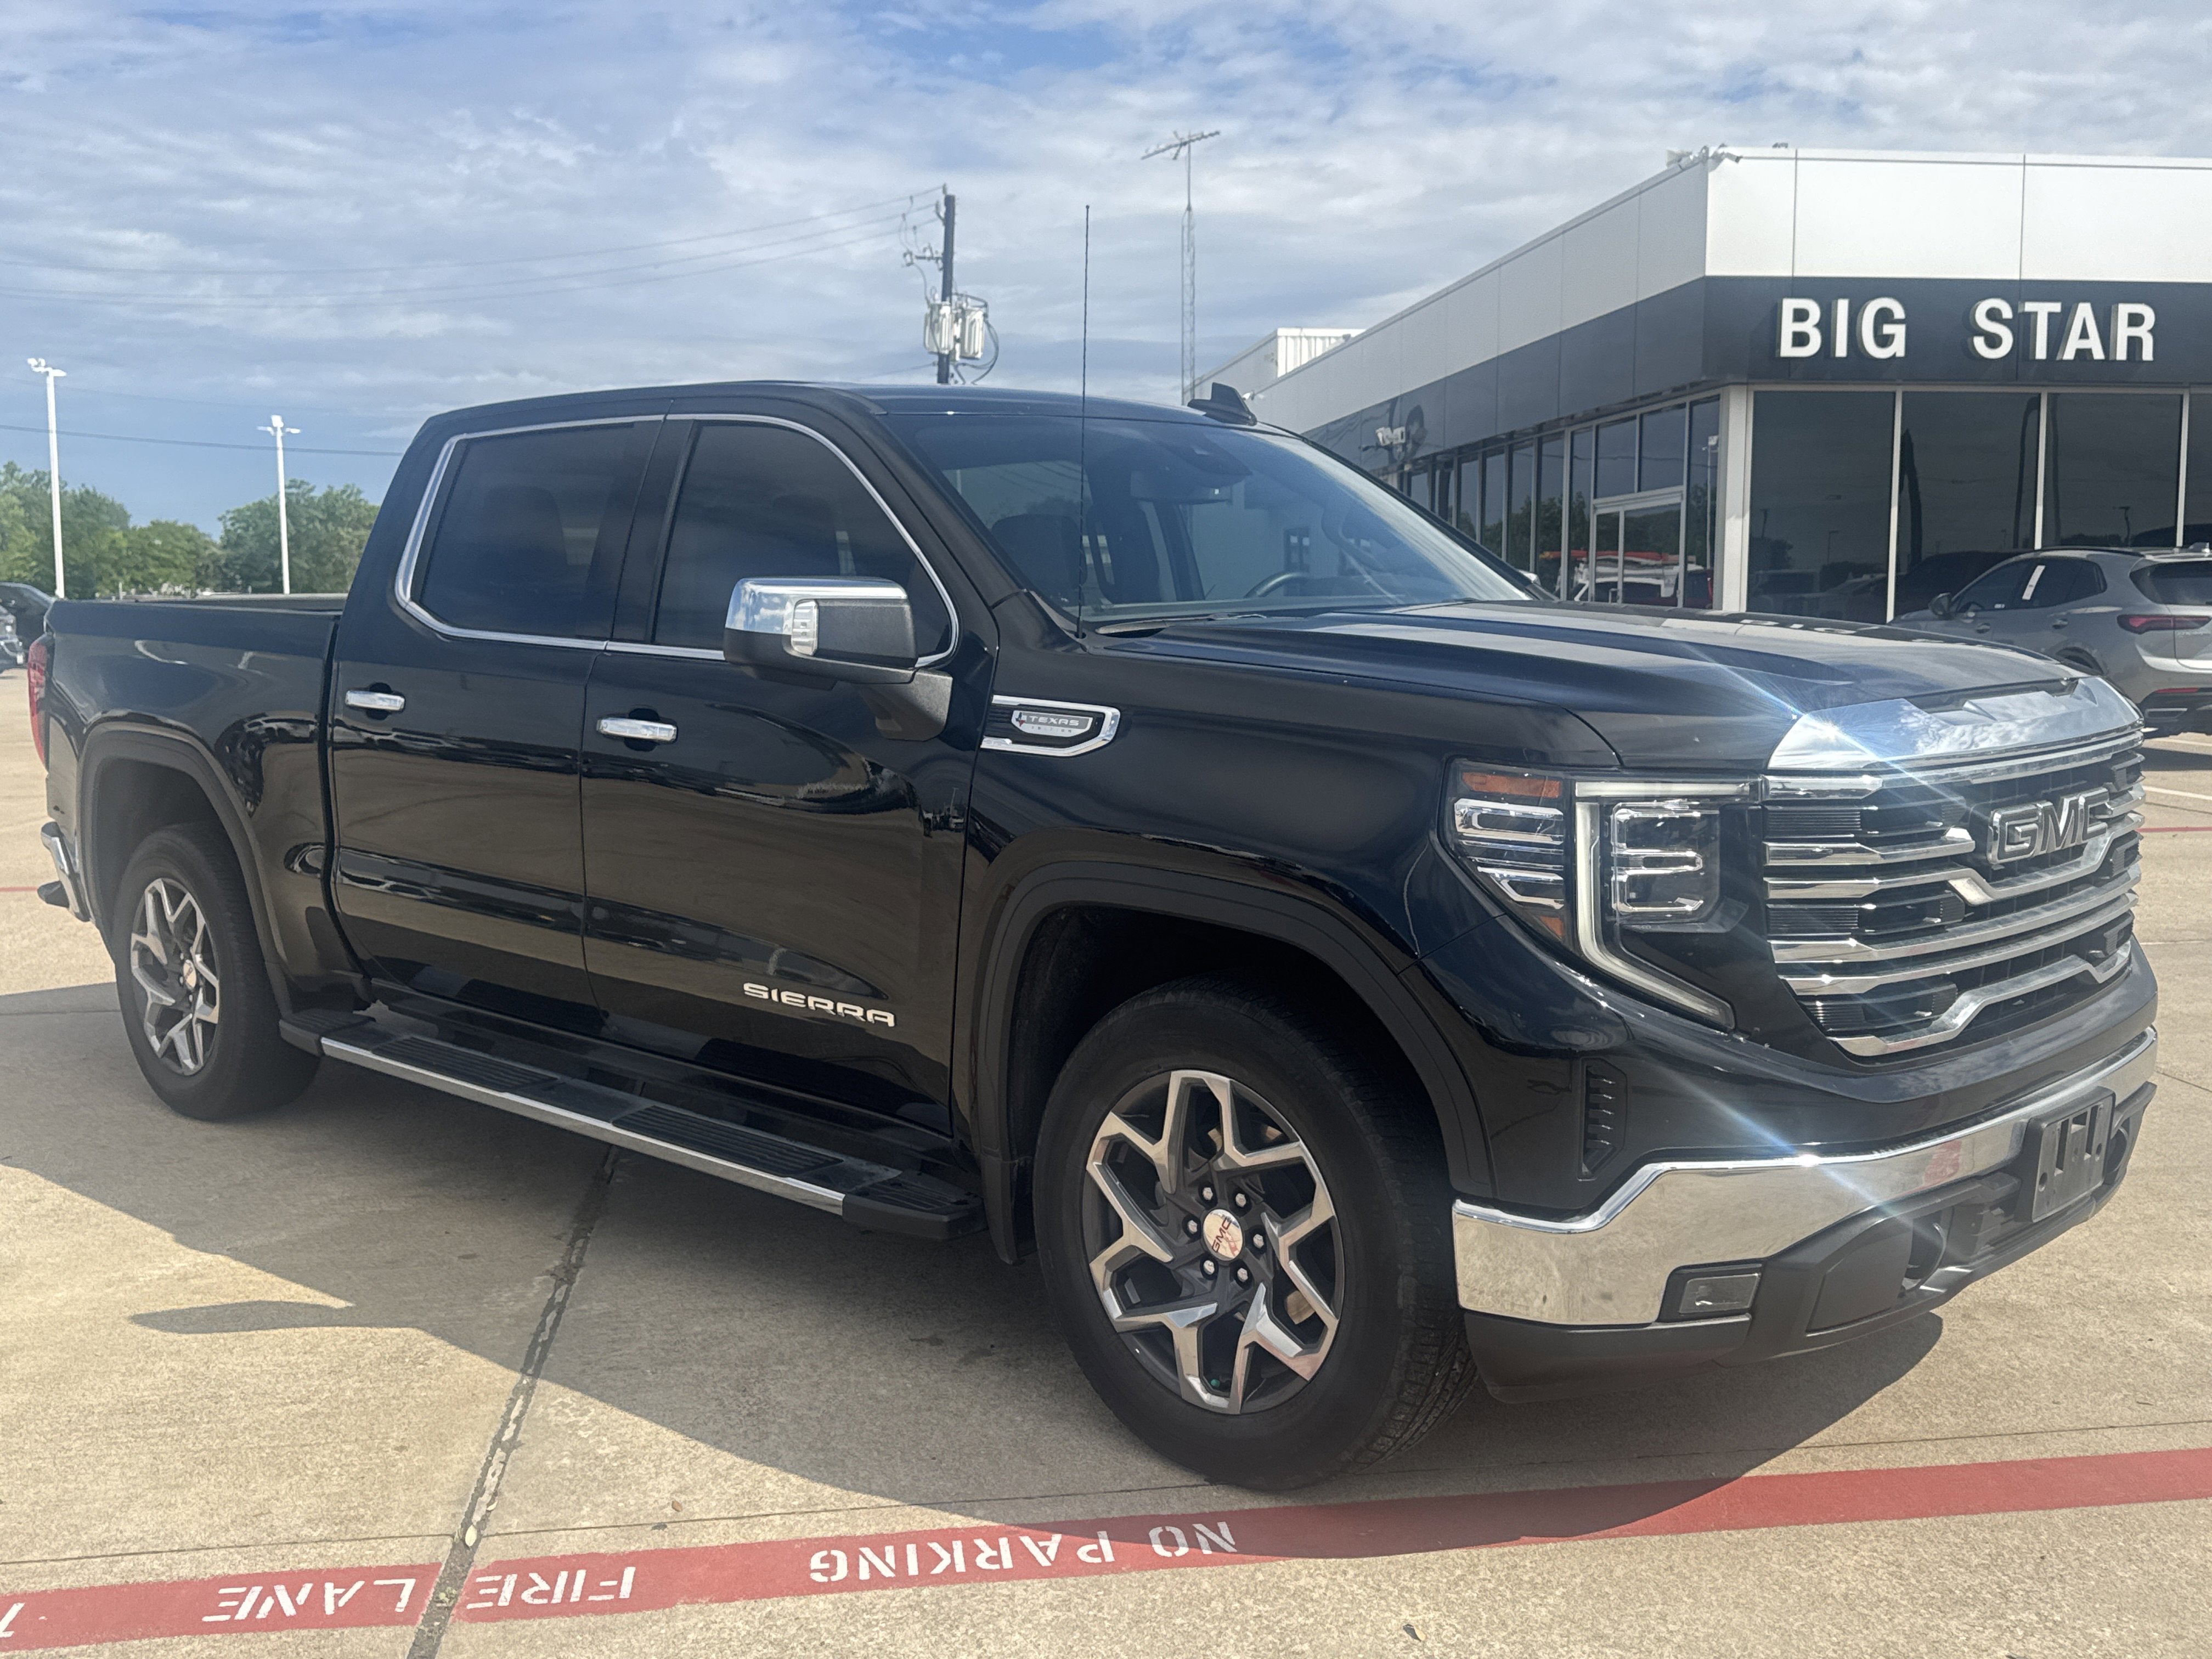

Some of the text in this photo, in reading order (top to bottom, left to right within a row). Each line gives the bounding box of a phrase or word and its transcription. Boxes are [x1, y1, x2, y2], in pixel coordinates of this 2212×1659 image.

[1779, 297, 2157, 362] BIG STAR
[1029, 715, 1080, 726] TEXAS
[1987, 787, 2114, 865] GMC
[743, 982, 895, 1028] SIERRA
[1211, 1216, 1232, 1253] GMC
[201, 1521, 1238, 1622] NO PARKING FIRE LANE
